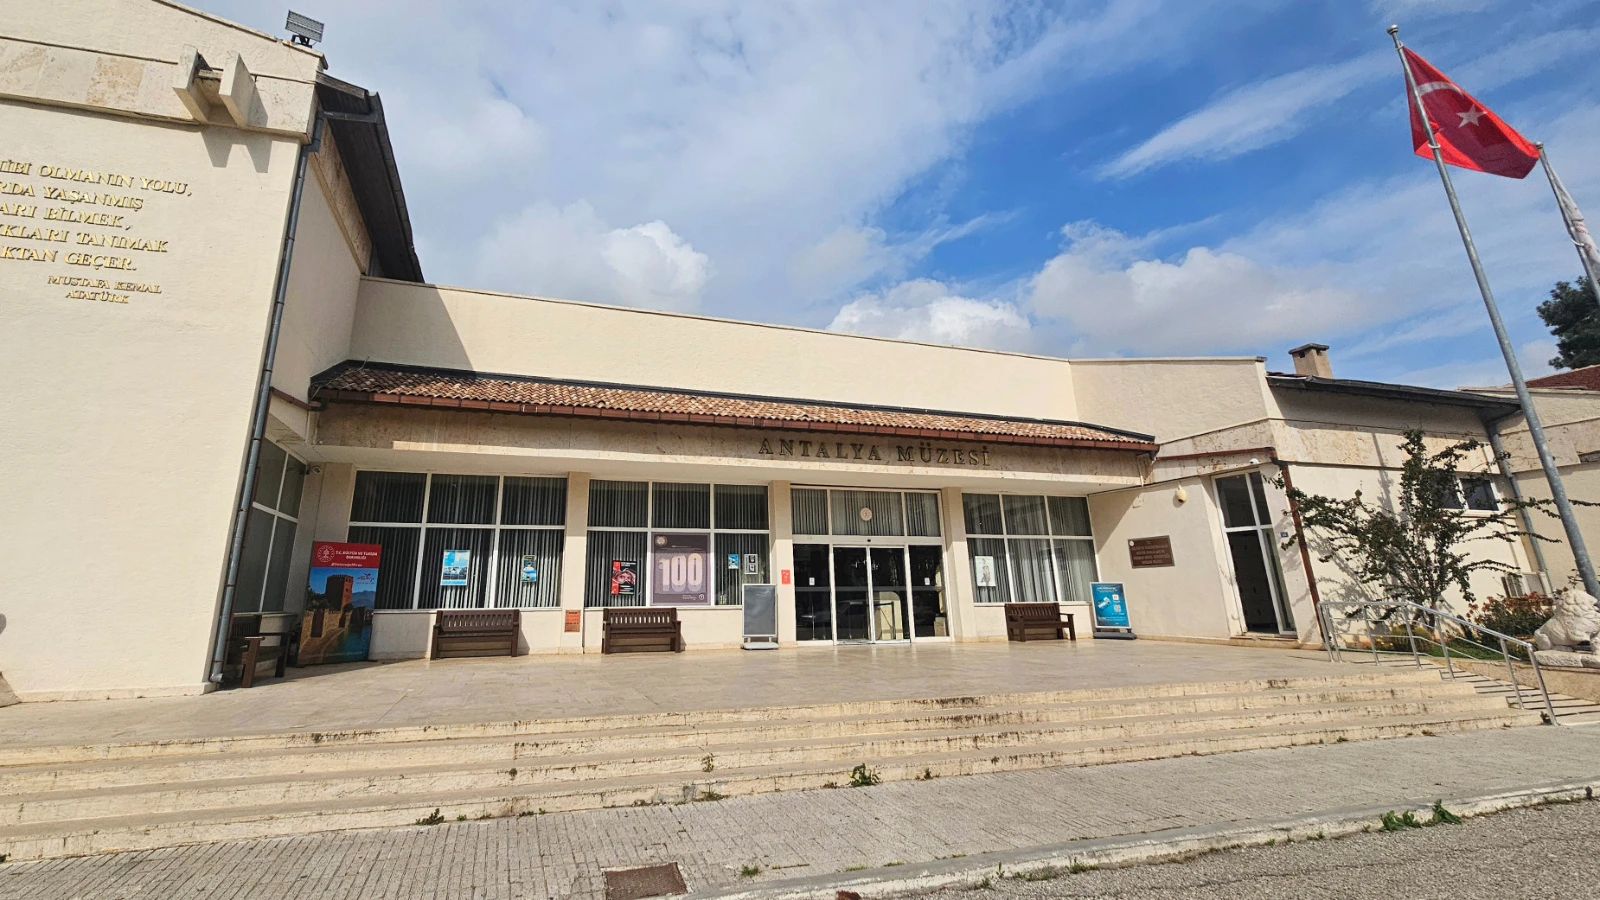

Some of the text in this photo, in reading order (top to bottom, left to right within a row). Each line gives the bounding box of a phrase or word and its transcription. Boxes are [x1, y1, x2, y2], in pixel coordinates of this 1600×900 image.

[38, 164, 134, 188] OLMANIN
[140, 177, 192, 196] YOLU,
[43, 186, 143, 212] YAŞANMIŞ
[43, 206, 131, 230] BİLMEK,
[0, 224, 168, 252] KLARI TANIMAK
[64, 252, 137, 270] GEÇER.
[47, 275, 162, 294] MUSTAFA KEMAL
[65, 289, 130, 304] ATATÜRK
[758, 438, 991, 467] ANTALYA MÜZESİ
[658, 553, 702, 592] 100
